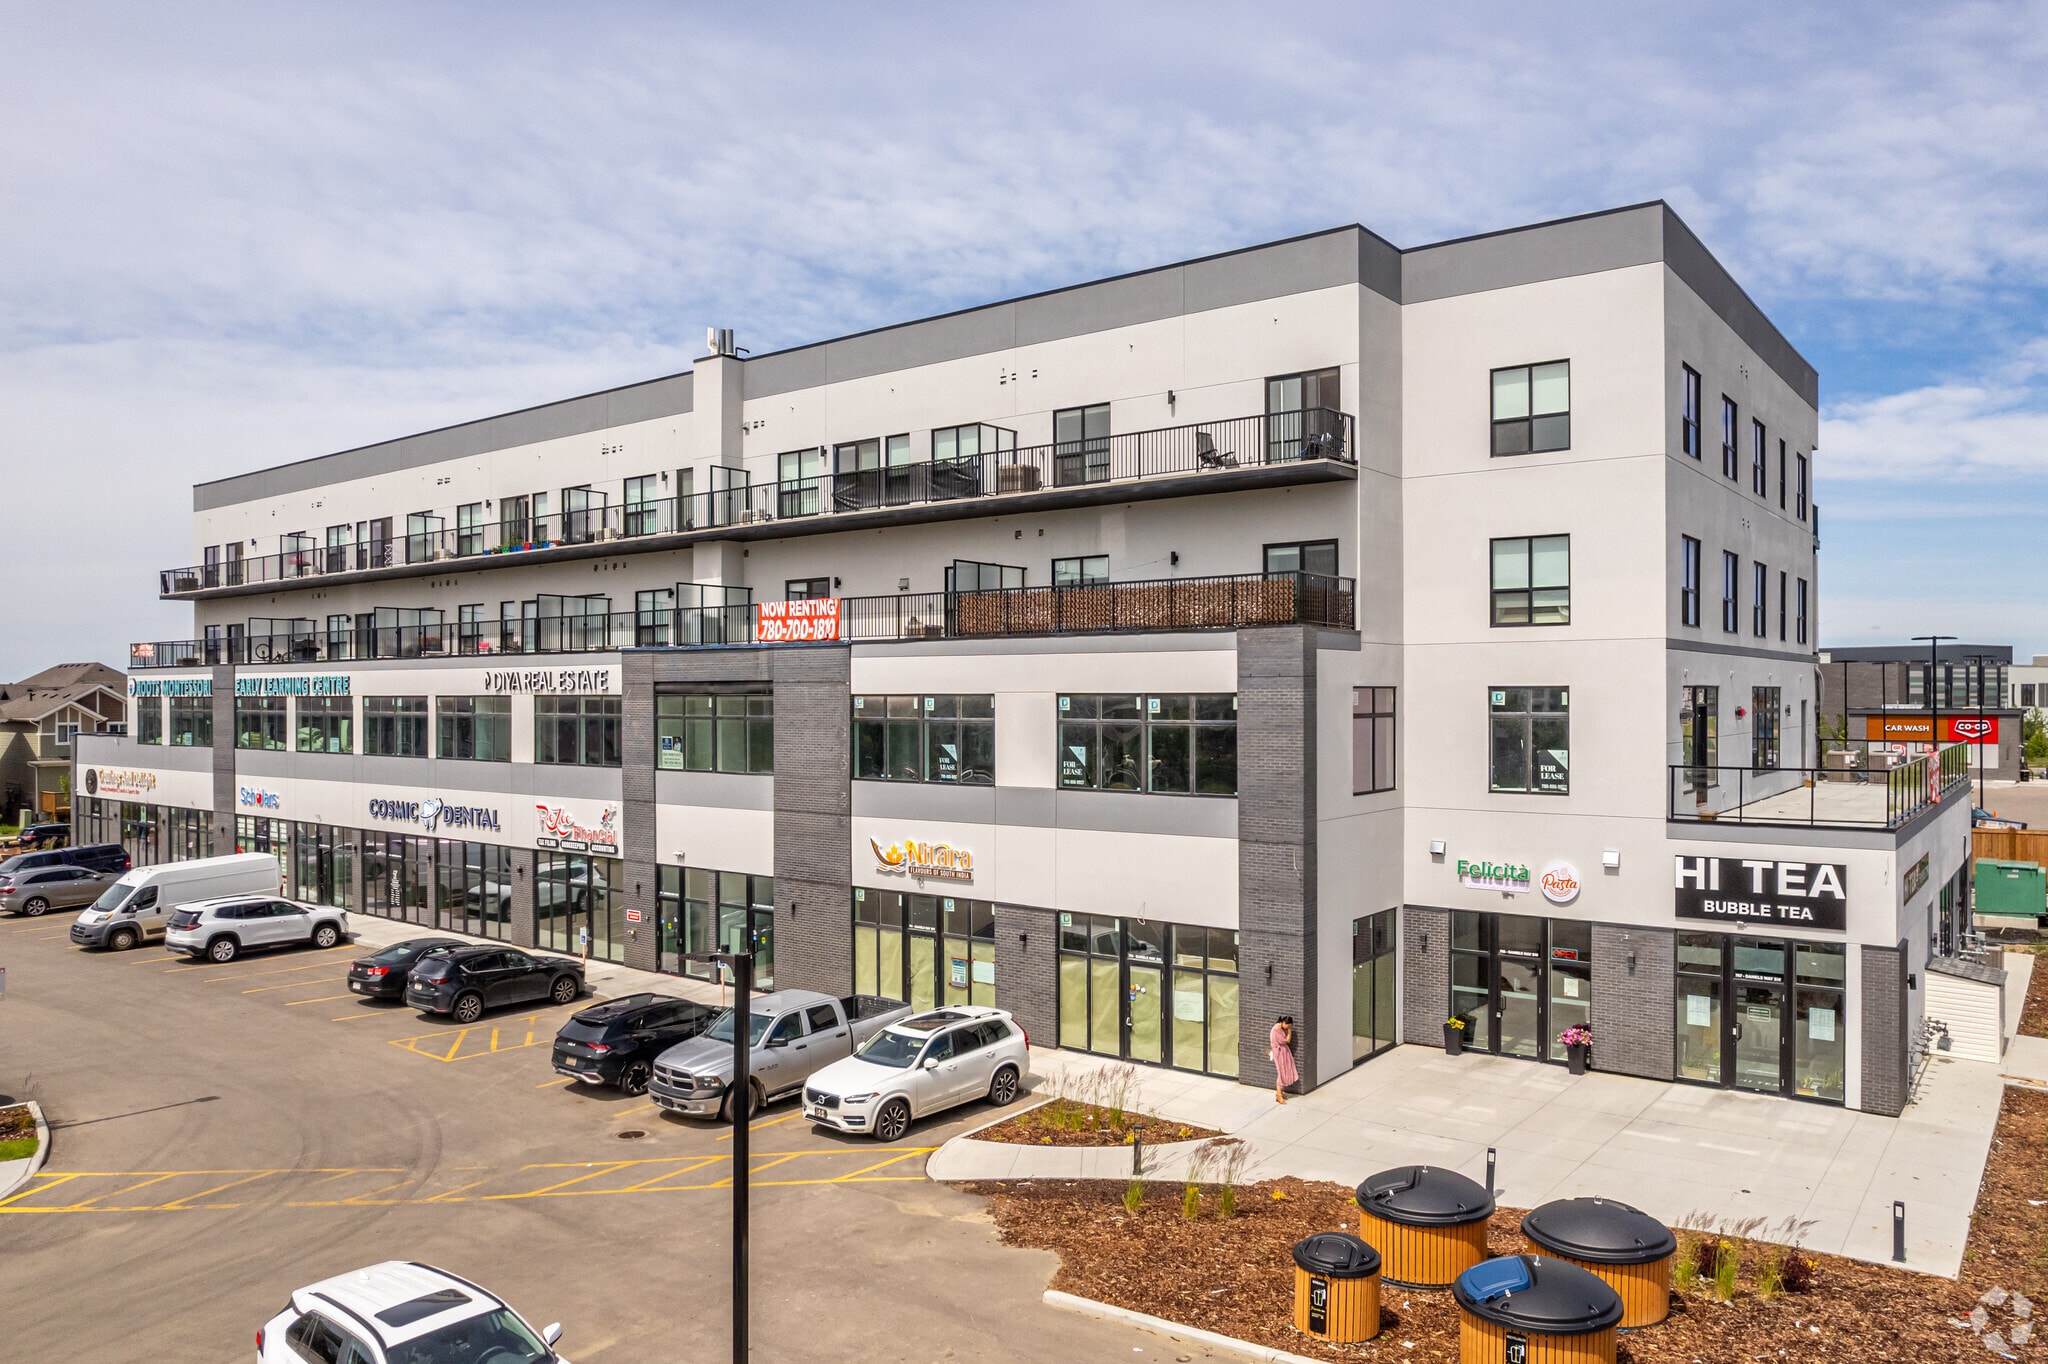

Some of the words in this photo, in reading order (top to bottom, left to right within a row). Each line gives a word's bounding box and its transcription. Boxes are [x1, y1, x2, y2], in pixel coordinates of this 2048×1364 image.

[761, 601, 787, 618] NOW
[135, 680, 161, 697] ROOTS
[162, 679, 213, 697] MONTESSORI
[235, 678, 262, 696] EARLY
[262, 676, 310, 696] LEARNING
[311, 676, 350, 696] CENTRE
[493, 672, 522, 692] DIYA
[523, 671, 555, 692] REAL
[558, 669, 609, 691] ESTATE
[1884, 724, 1903, 732] CAR
[1903, 724, 1930, 732] WASH
[1958, 723, 1988, 731] CO-OP
[1063, 768, 1083, 776] LEASE
[1540, 764, 1556, 772] FOR
[1540, 772, 1565, 780] LEASE
[240, 787, 279, 808] Scholars
[369, 798, 419, 821] COSMIC
[443, 805, 501, 829] DENTAL
[904, 839, 972, 869] Nitara
[910, 866, 932, 876] FLAVOURS
[932, 868, 939, 877] OF
[940, 869, 956, 878] SOUTH
[1457, 859, 1529, 881] Felicità
[1675, 856, 1720, 891] HI
[1742, 859, 1847, 900] TEA
[1541, 873, 1578, 890] Pasta
[1704, 900, 1771, 917] BUBBLE
[1777, 905, 1813, 920] TEA
[1552, 948, 1577, 960] OPEN
